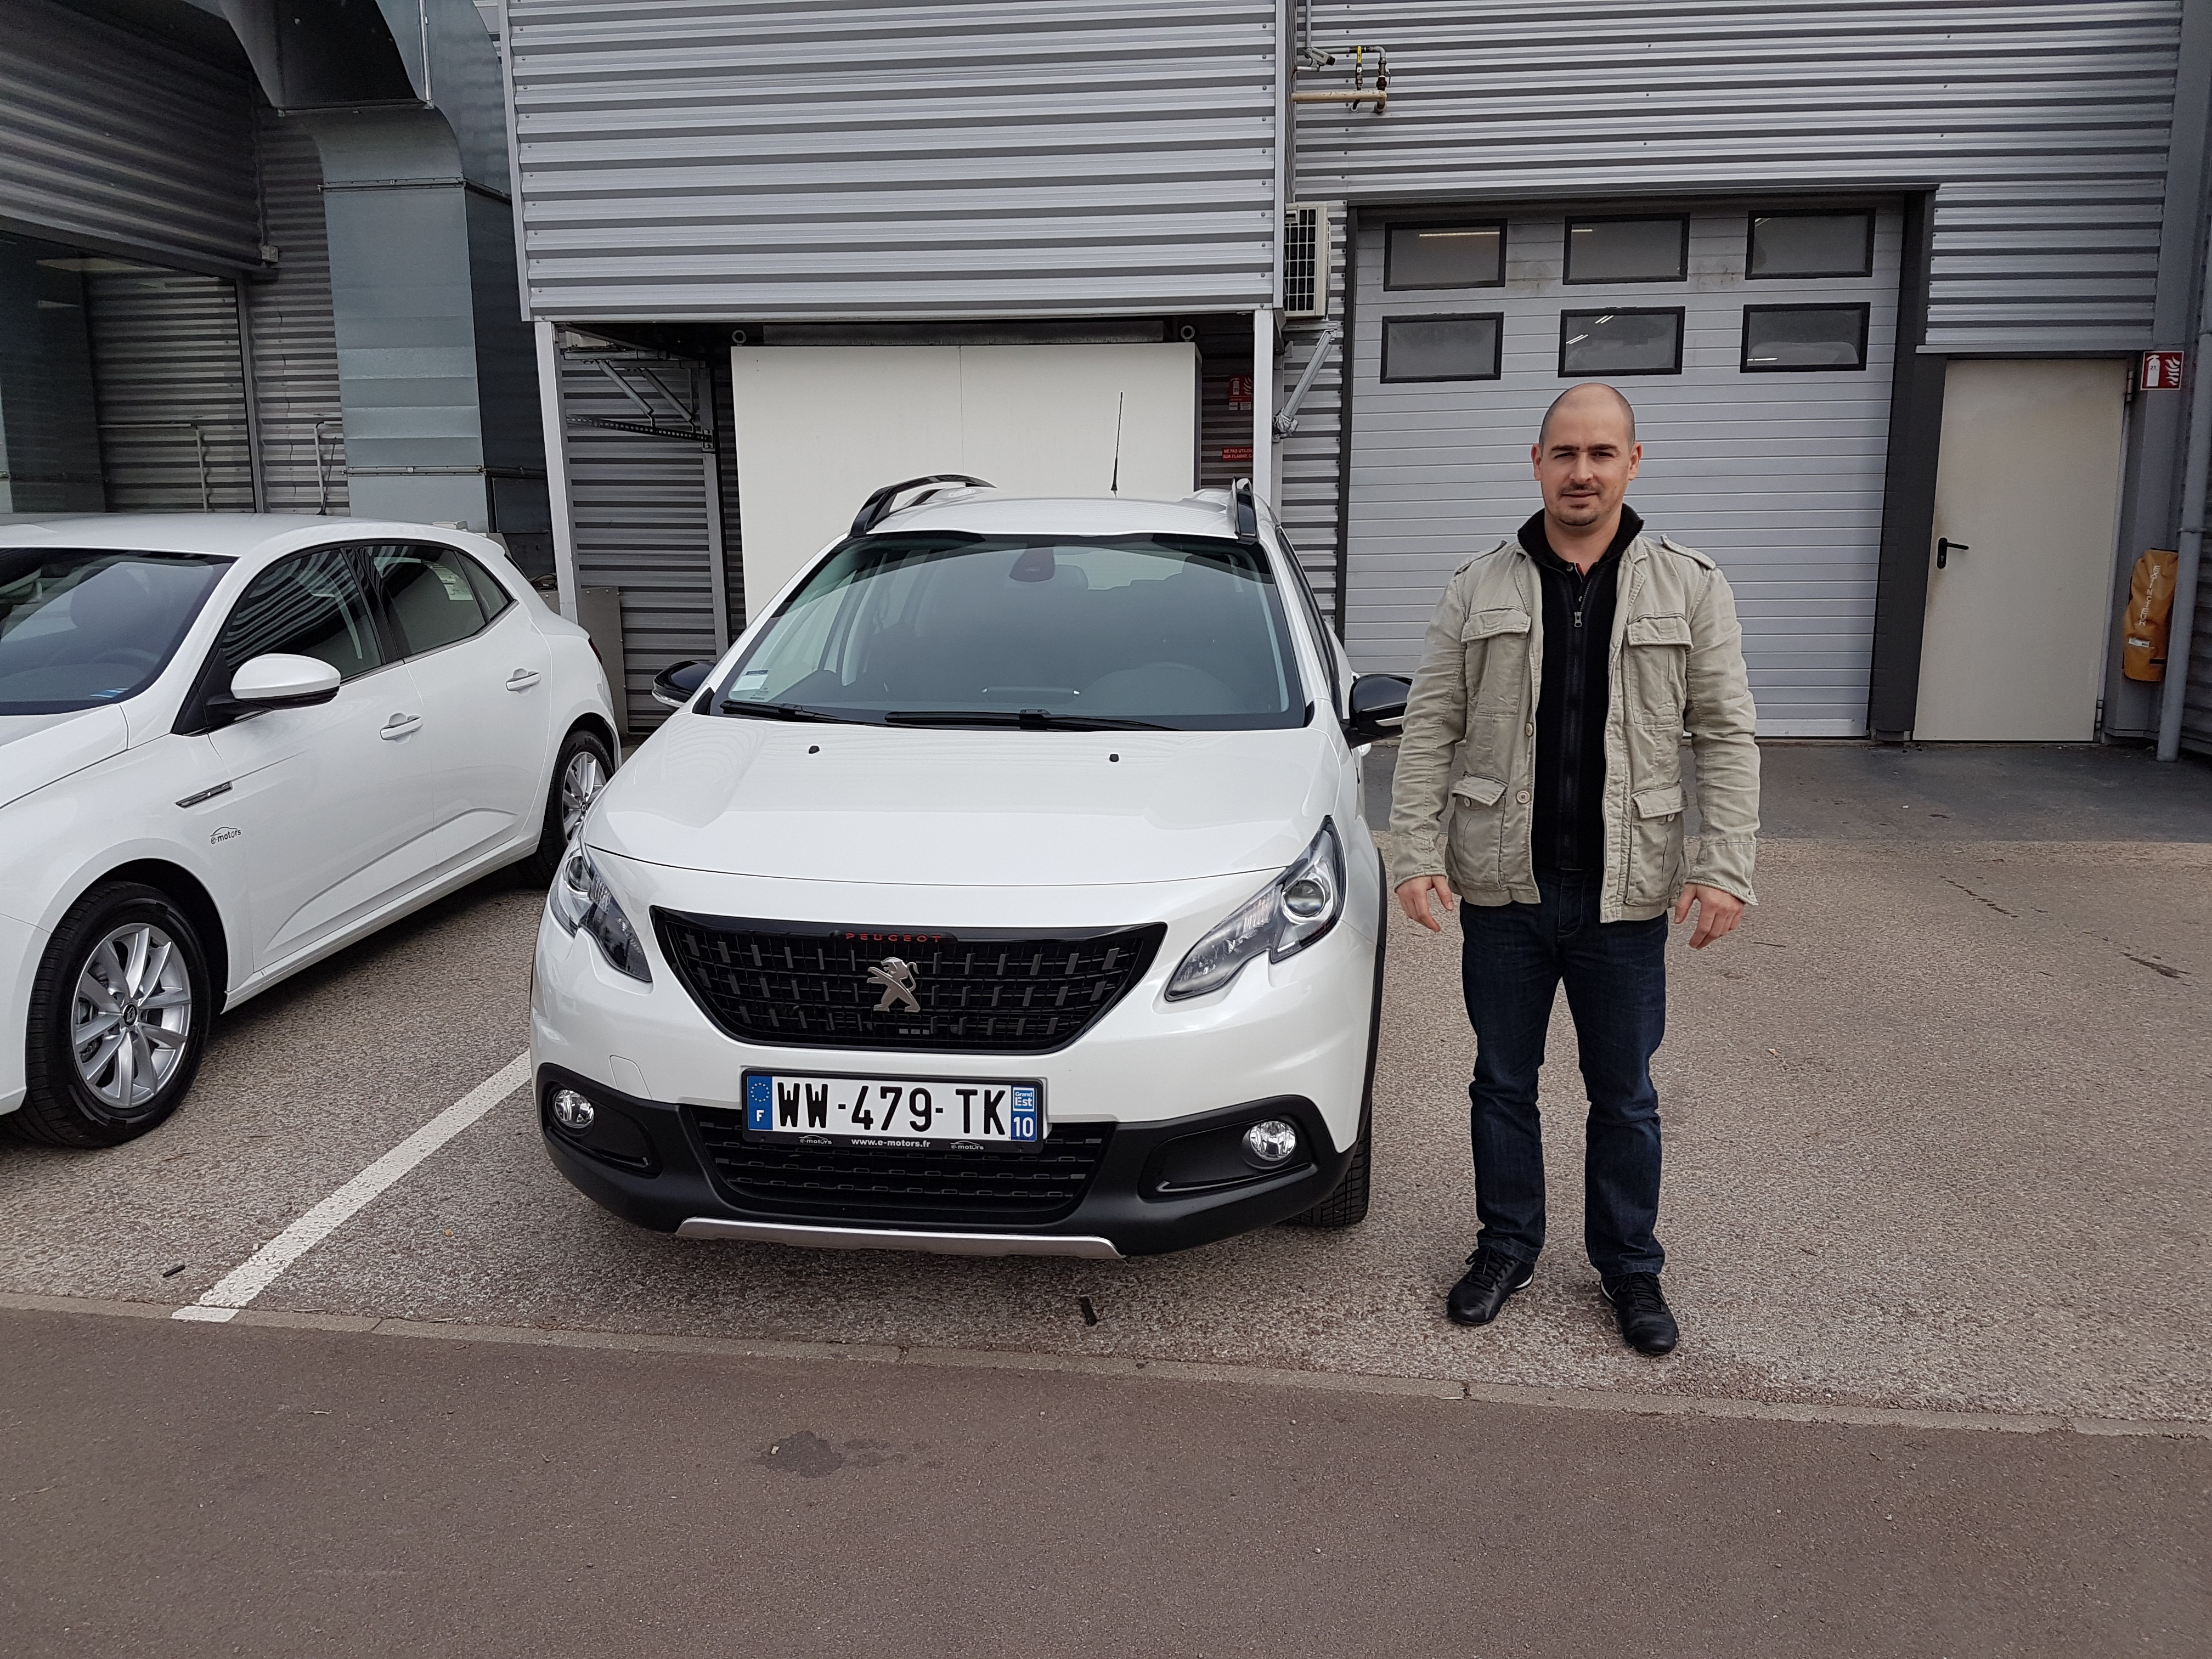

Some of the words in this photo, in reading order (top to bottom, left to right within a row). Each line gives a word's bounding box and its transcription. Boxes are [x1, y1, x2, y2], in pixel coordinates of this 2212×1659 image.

[2138, 565, 2161, 627] EXTINCTEUR
[845, 932, 941, 943] PEUGEOT
[1015, 1097, 1032, 1107] Est
[756, 1109, 764, 1122] F
[777, 1082, 1006, 1136] WW-479-TK
[1013, 1116, 1034, 1137] 10
[851, 1138, 931, 1148] www.e-motors.fr
